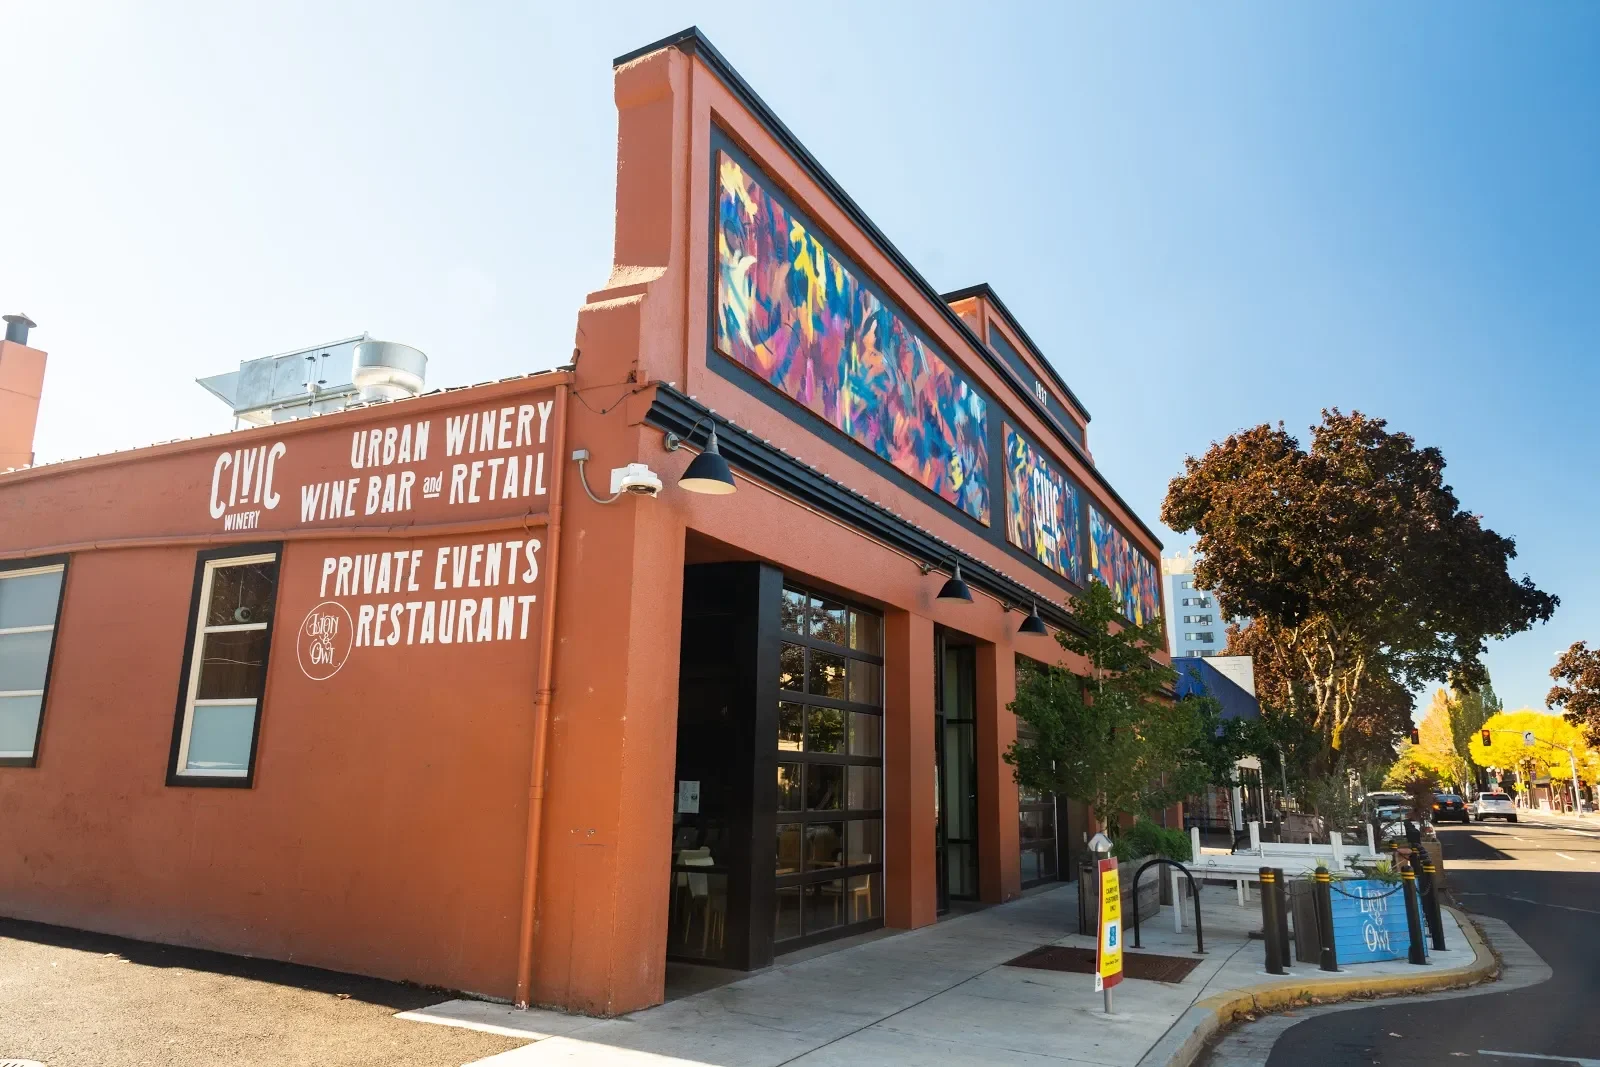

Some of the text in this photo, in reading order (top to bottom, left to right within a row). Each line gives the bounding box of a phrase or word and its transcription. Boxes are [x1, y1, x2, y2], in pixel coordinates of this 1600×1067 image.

[350, 400, 553, 469] URBAN WINERY
[209, 441, 286, 519] CIVIC
[300, 453, 547, 522] WINE BAR and RETAIL
[1033, 467, 1061, 542] CIVIC
[224, 510, 260, 531] WINERY
[319, 538, 541, 598] PRIVATE EVENTS
[355, 595, 536, 647] RESTAURANT
